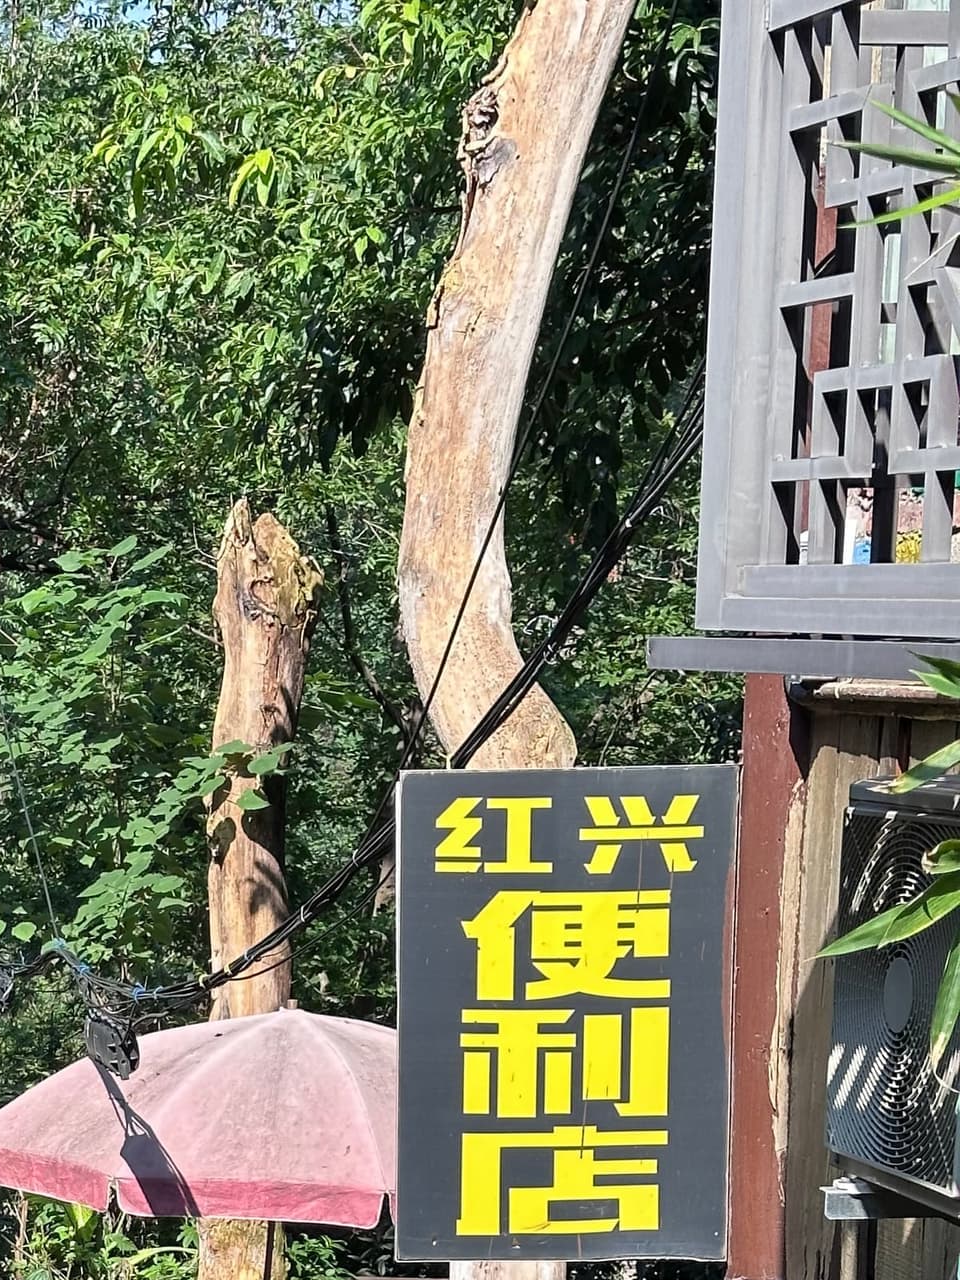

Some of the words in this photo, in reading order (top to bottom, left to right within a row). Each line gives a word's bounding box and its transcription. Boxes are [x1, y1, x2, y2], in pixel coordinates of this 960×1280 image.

[434, 794, 704, 874] 红兴
[456, 889, 672, 1236] 便利店
